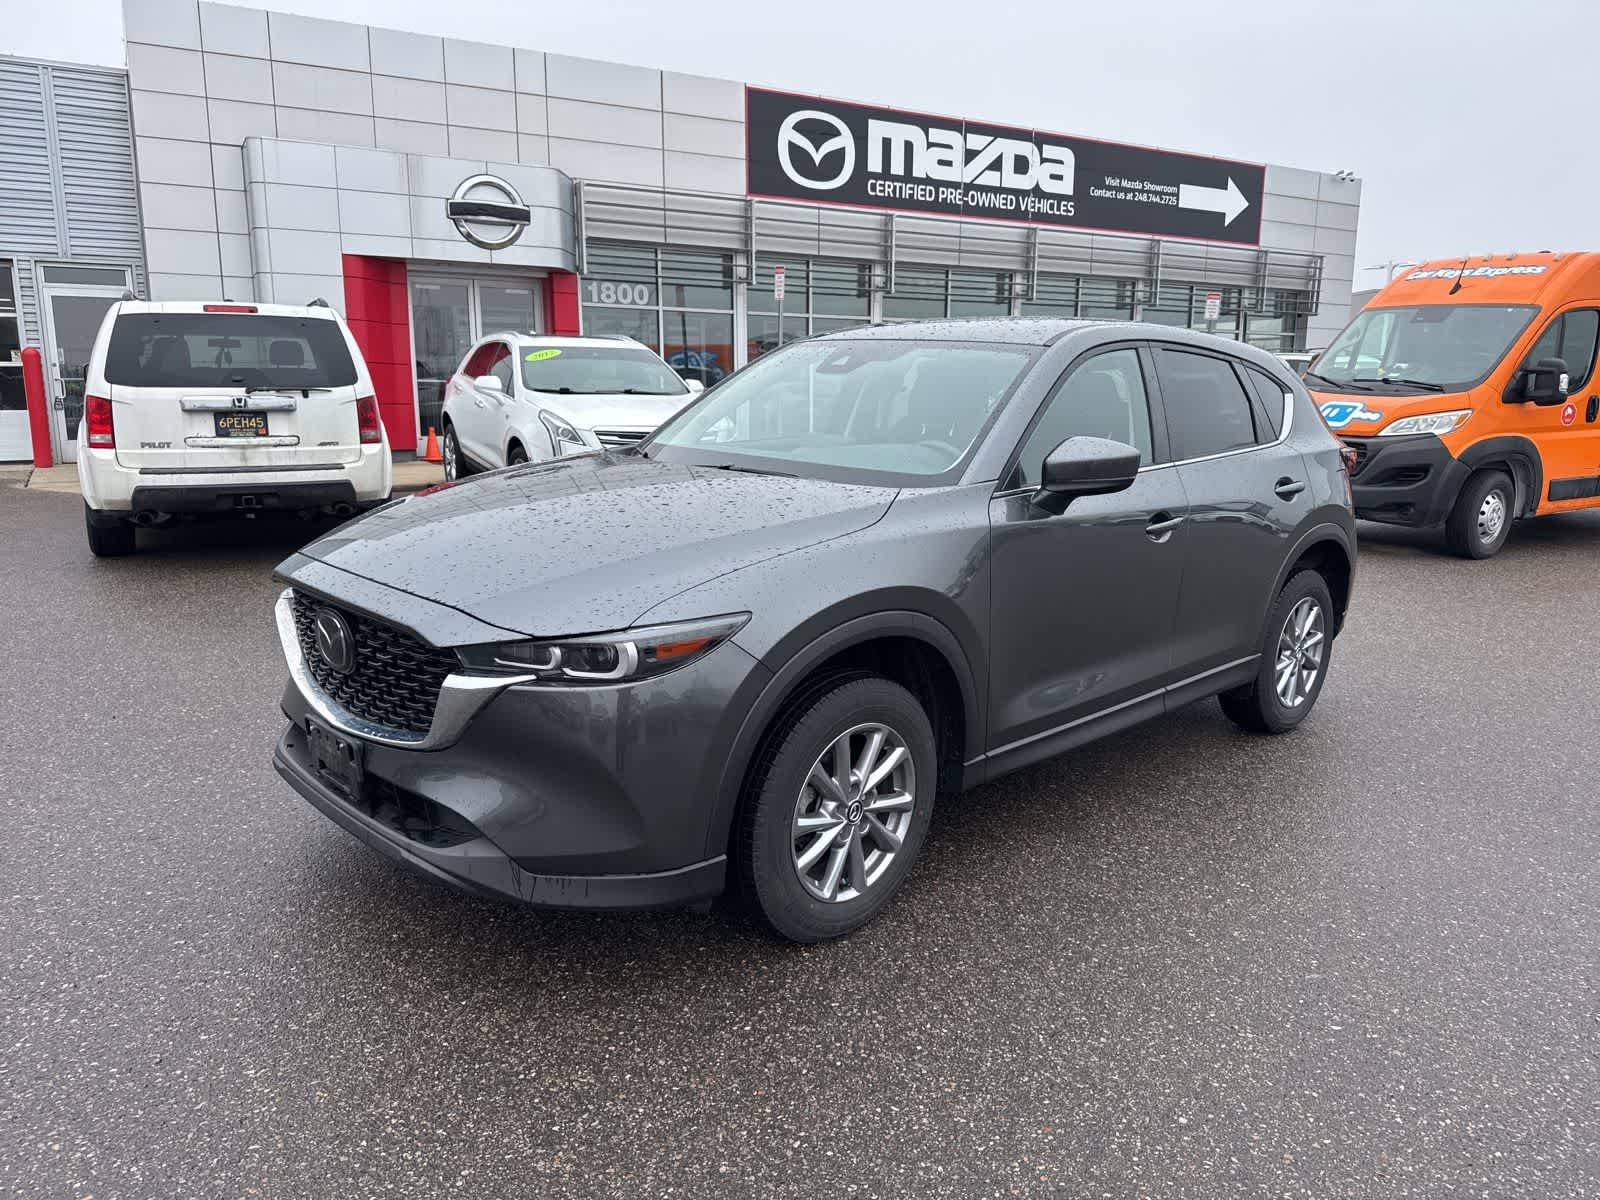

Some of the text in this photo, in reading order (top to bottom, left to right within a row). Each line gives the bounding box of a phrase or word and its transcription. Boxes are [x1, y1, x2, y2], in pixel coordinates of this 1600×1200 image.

[1104, 175, 1178, 194] Visit Mazda Showroom
[867, 179, 1075, 217] CERTIFIED PRE-OWNED VEHICLES
[1089, 186, 1177, 206] Contact us at 248.744.2725
[1474, 264, 1547, 278] Express
[587, 280, 649, 305] 1800
[219, 416, 264, 428] 6PEH45
[140, 441, 173, 449] PILOT
